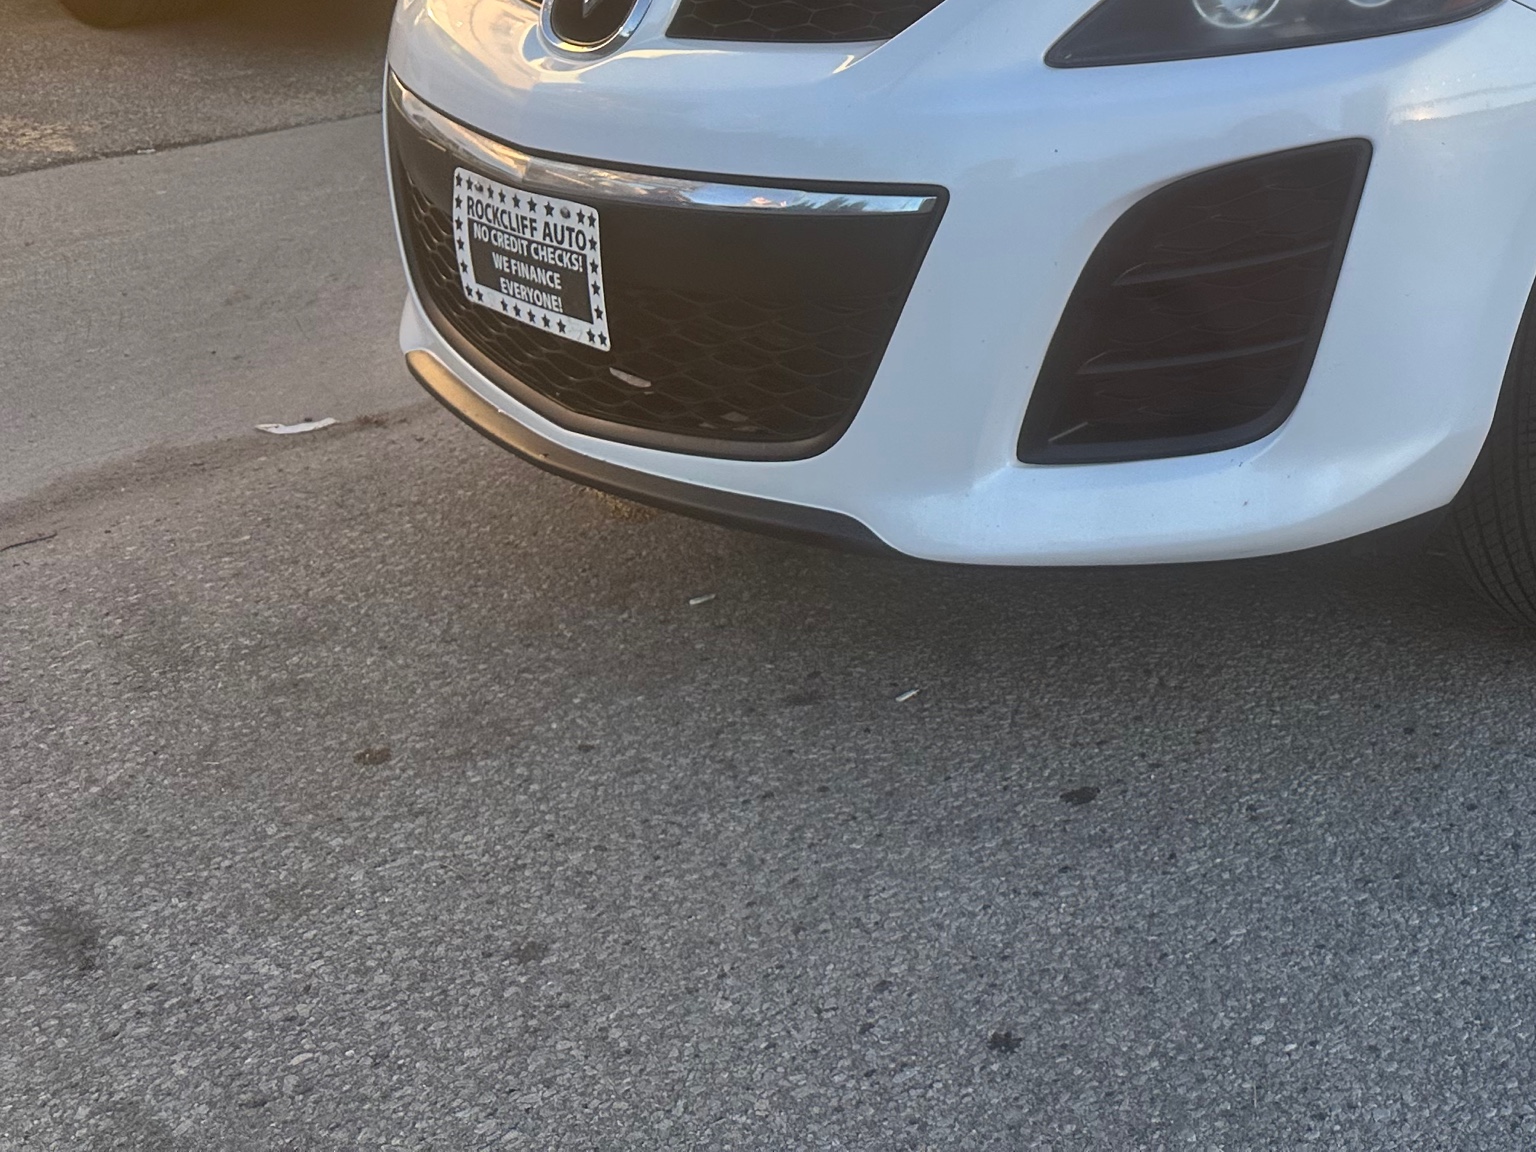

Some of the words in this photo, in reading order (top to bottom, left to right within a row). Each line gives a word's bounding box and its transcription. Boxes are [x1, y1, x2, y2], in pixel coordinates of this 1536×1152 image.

[467, 195, 537, 237] ROCKCLIFF
[542, 221, 586, 251] AUTO
[473, 223, 489, 242] NO
[491, 228, 529, 256] CREDIT
[530, 242, 583, 272] CHECKS!
[492, 252, 509, 273] WE
[511, 259, 562, 289] FINANCE
[500, 277, 563, 313] EVERYONE!
